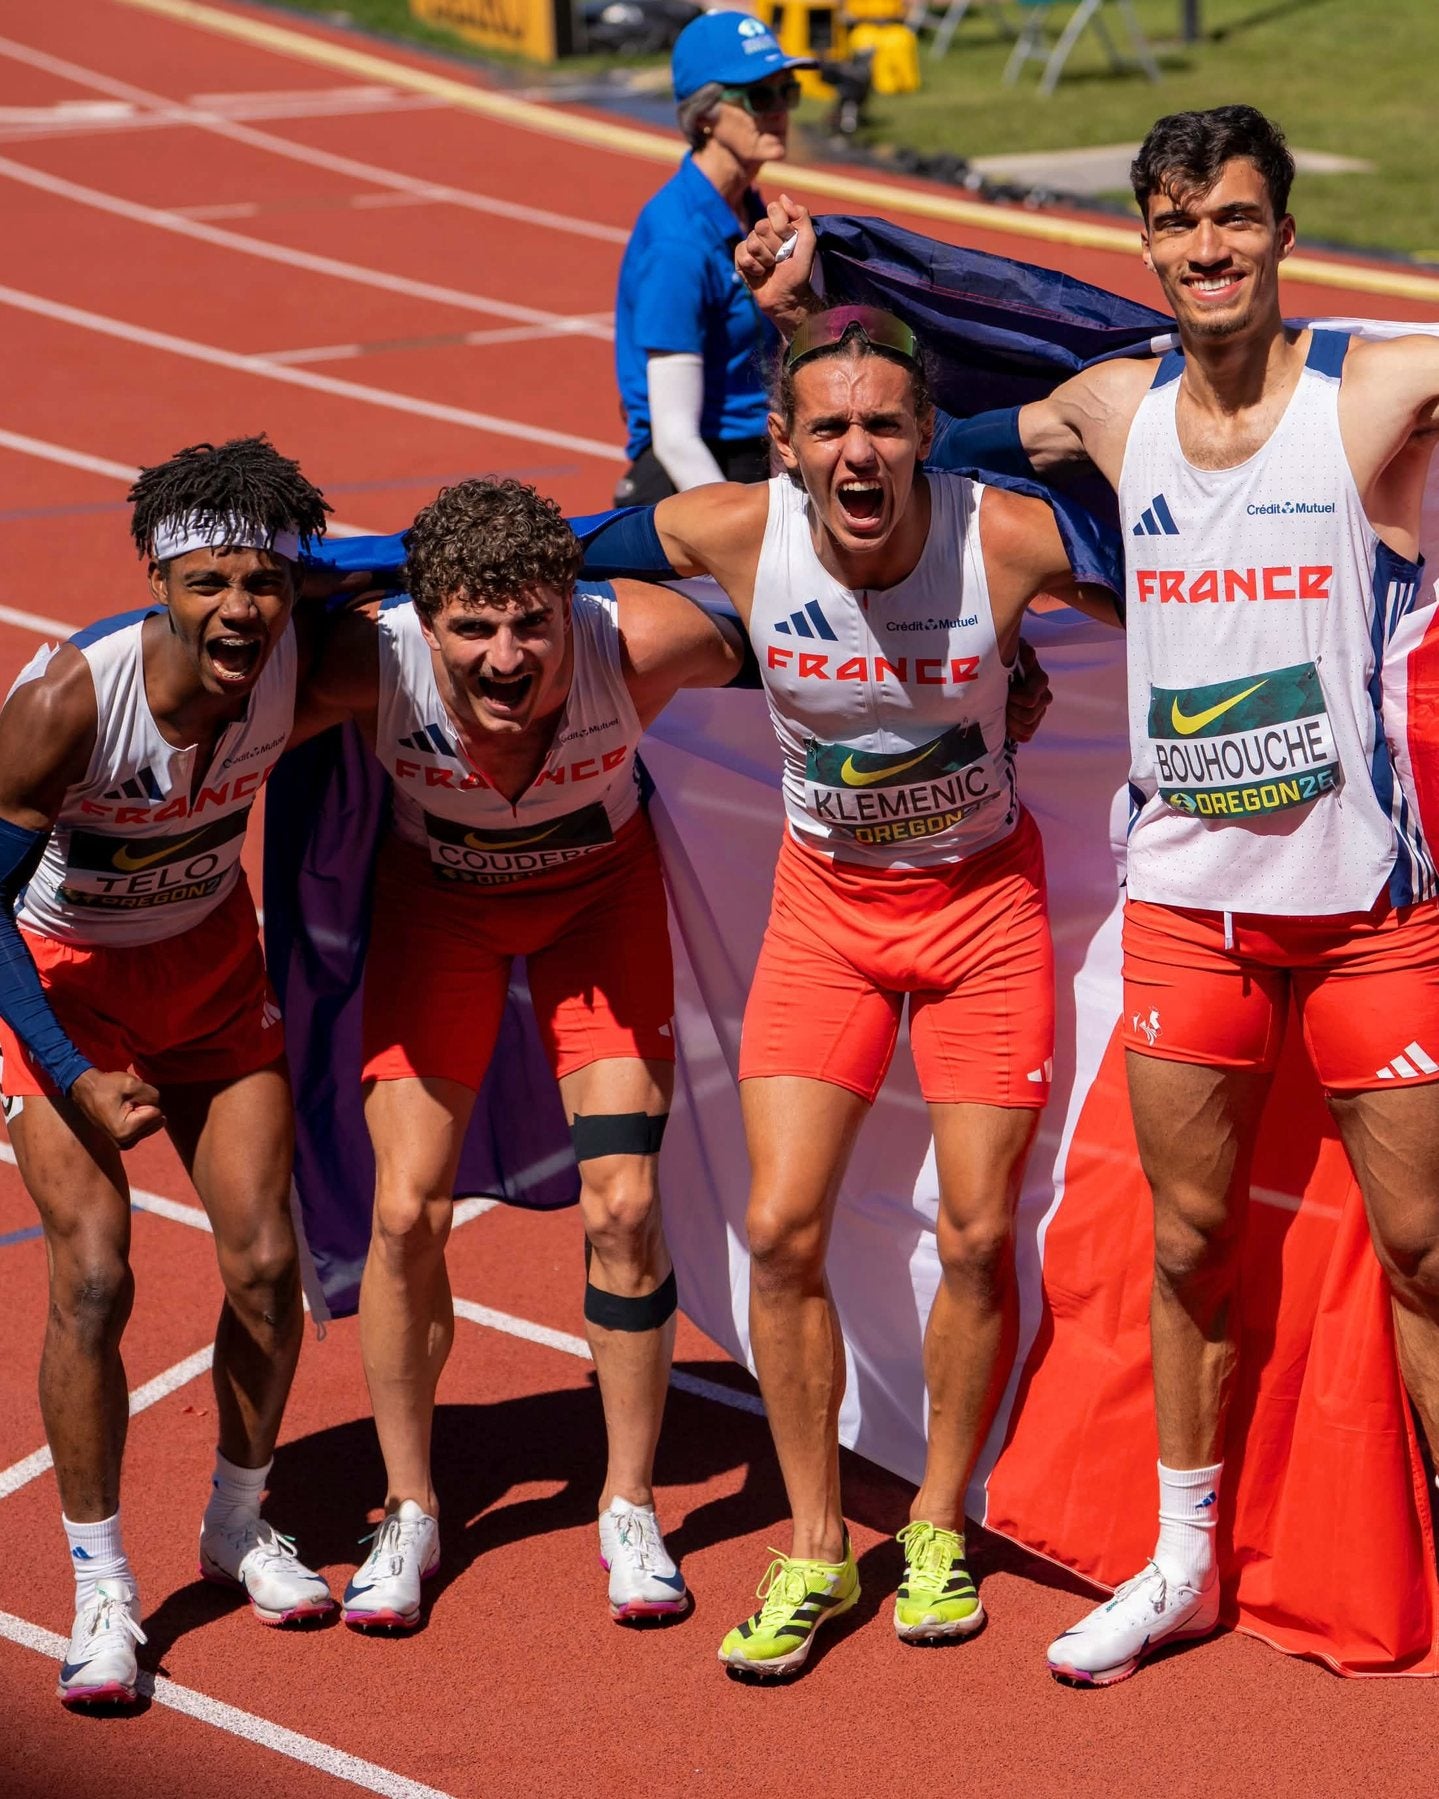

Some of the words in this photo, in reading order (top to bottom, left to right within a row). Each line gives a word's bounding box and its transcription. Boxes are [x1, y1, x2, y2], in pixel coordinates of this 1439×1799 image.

[1246, 502, 1281, 516] Crédit
[1294, 501, 1336, 514] Mutuel
[1136, 565, 1333, 604] FRANCE
[886, 619, 924, 633] Crédit
[938, 614, 979, 630] Mutuel
[767, 645, 980, 685] FRANCE
[1155, 721, 1328, 783] BOUHOUCHE
[813, 766, 989, 822] KLEMENIC
[855, 807, 972, 844] OREGON
[96, 853, 219, 894] TELO
[100, 876, 222, 909] OREGON2
